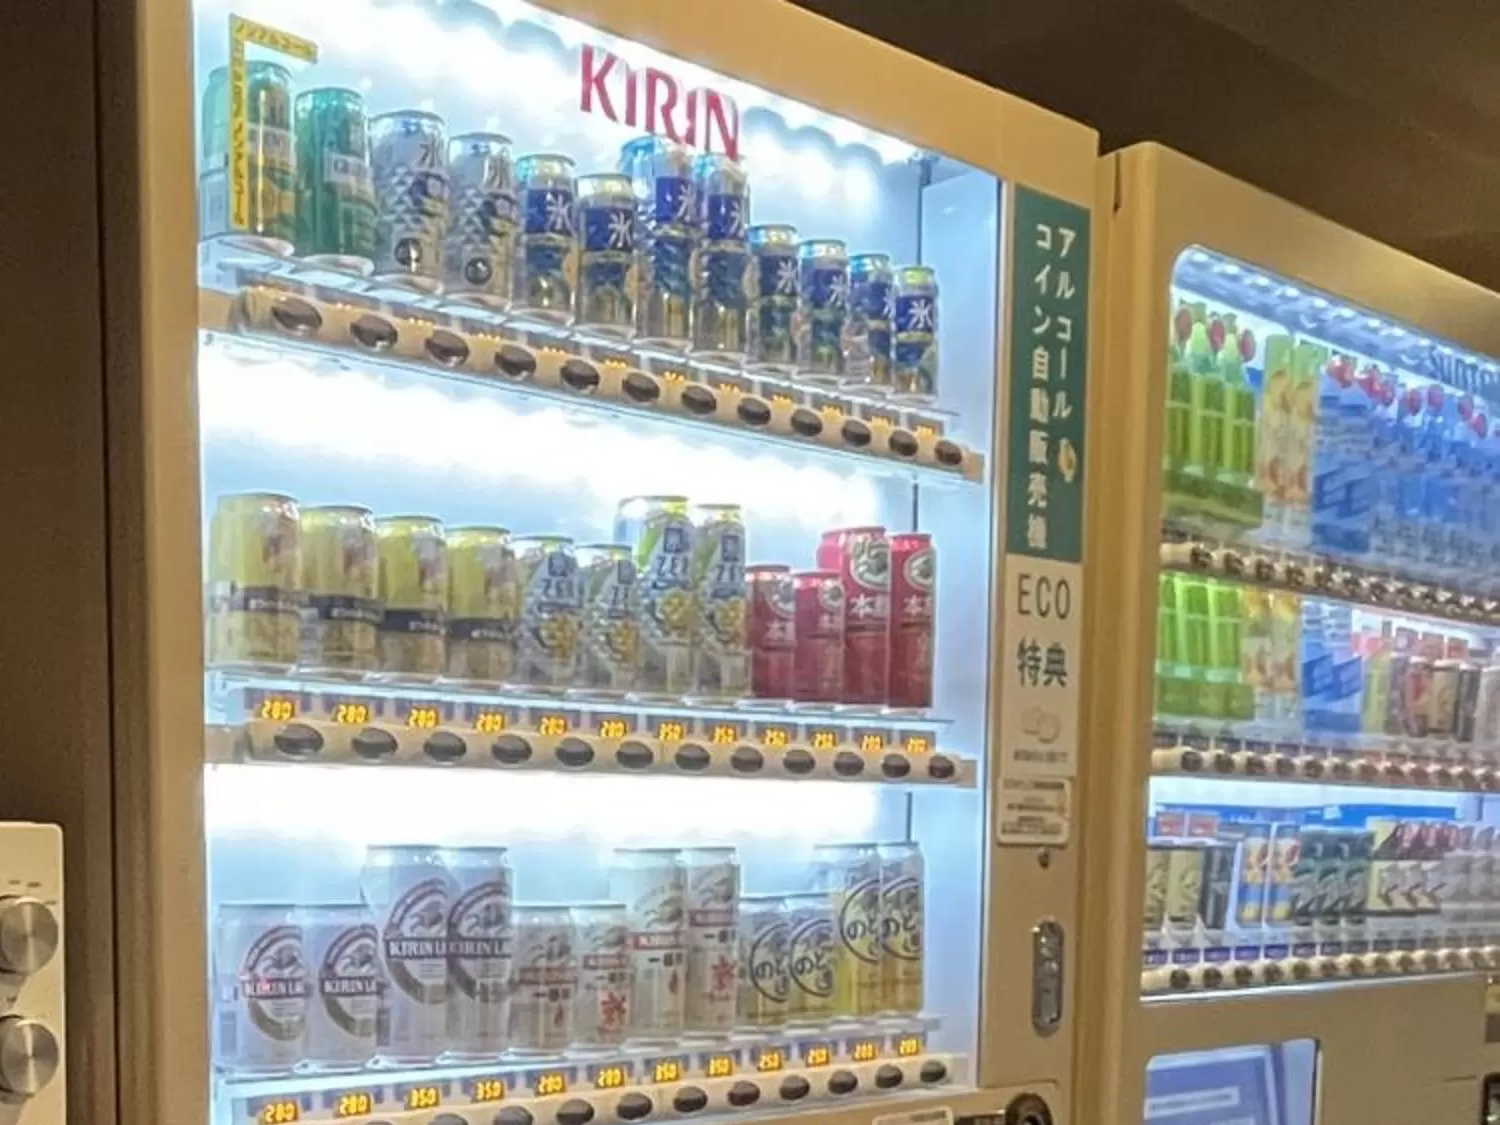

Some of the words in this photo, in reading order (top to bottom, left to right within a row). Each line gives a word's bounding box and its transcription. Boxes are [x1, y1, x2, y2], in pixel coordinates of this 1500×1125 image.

[580, 43, 738, 162] KIRIN
[608, 211, 634, 249] 氷
[908, 301, 934, 331] 氷
[1051, 227, 1077, 419] アルコール
[1027, 223, 1052, 549] コイン自動販売機
[1017, 572, 1071, 620] ECO
[1016, 638, 1069, 688] 特典
